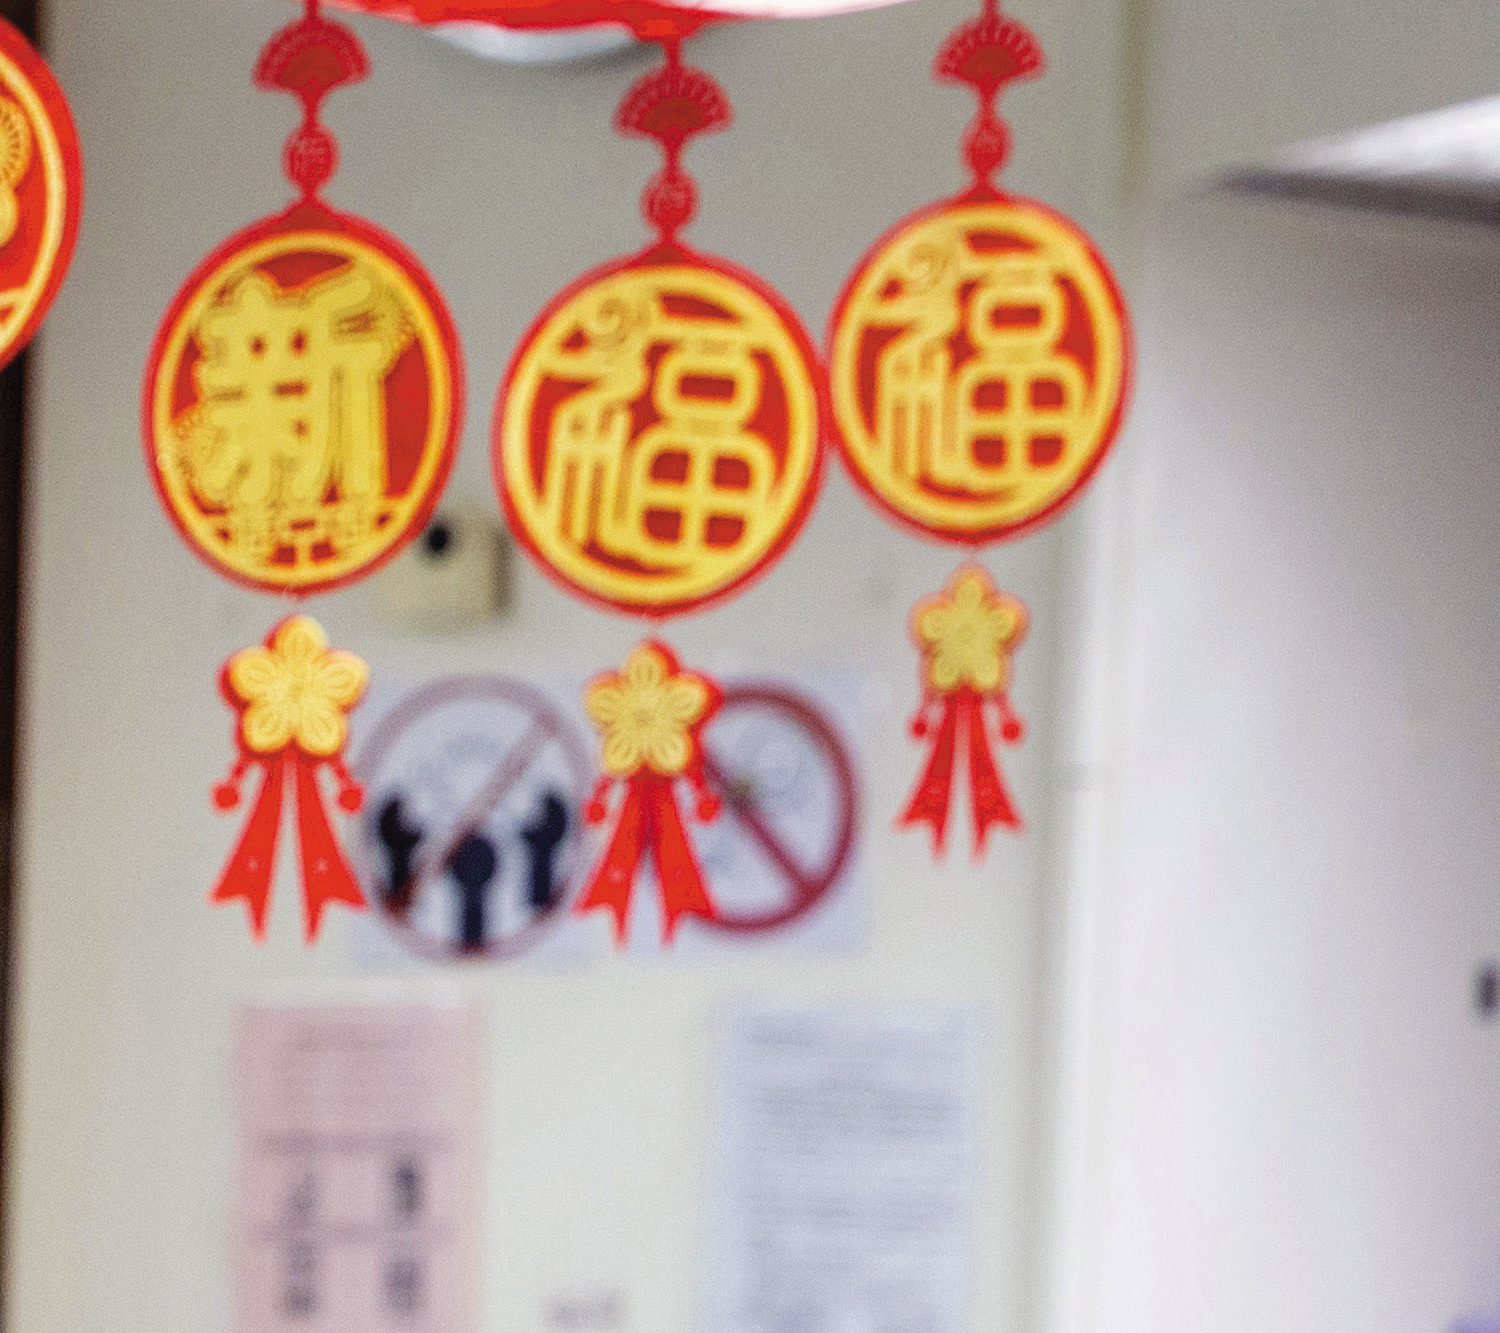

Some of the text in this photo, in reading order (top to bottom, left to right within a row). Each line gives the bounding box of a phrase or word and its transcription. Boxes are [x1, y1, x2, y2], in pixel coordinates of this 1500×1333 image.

[195, 265, 386, 510] 新
[538, 280, 784, 568] 福
[856, 238, 1092, 488] 福
